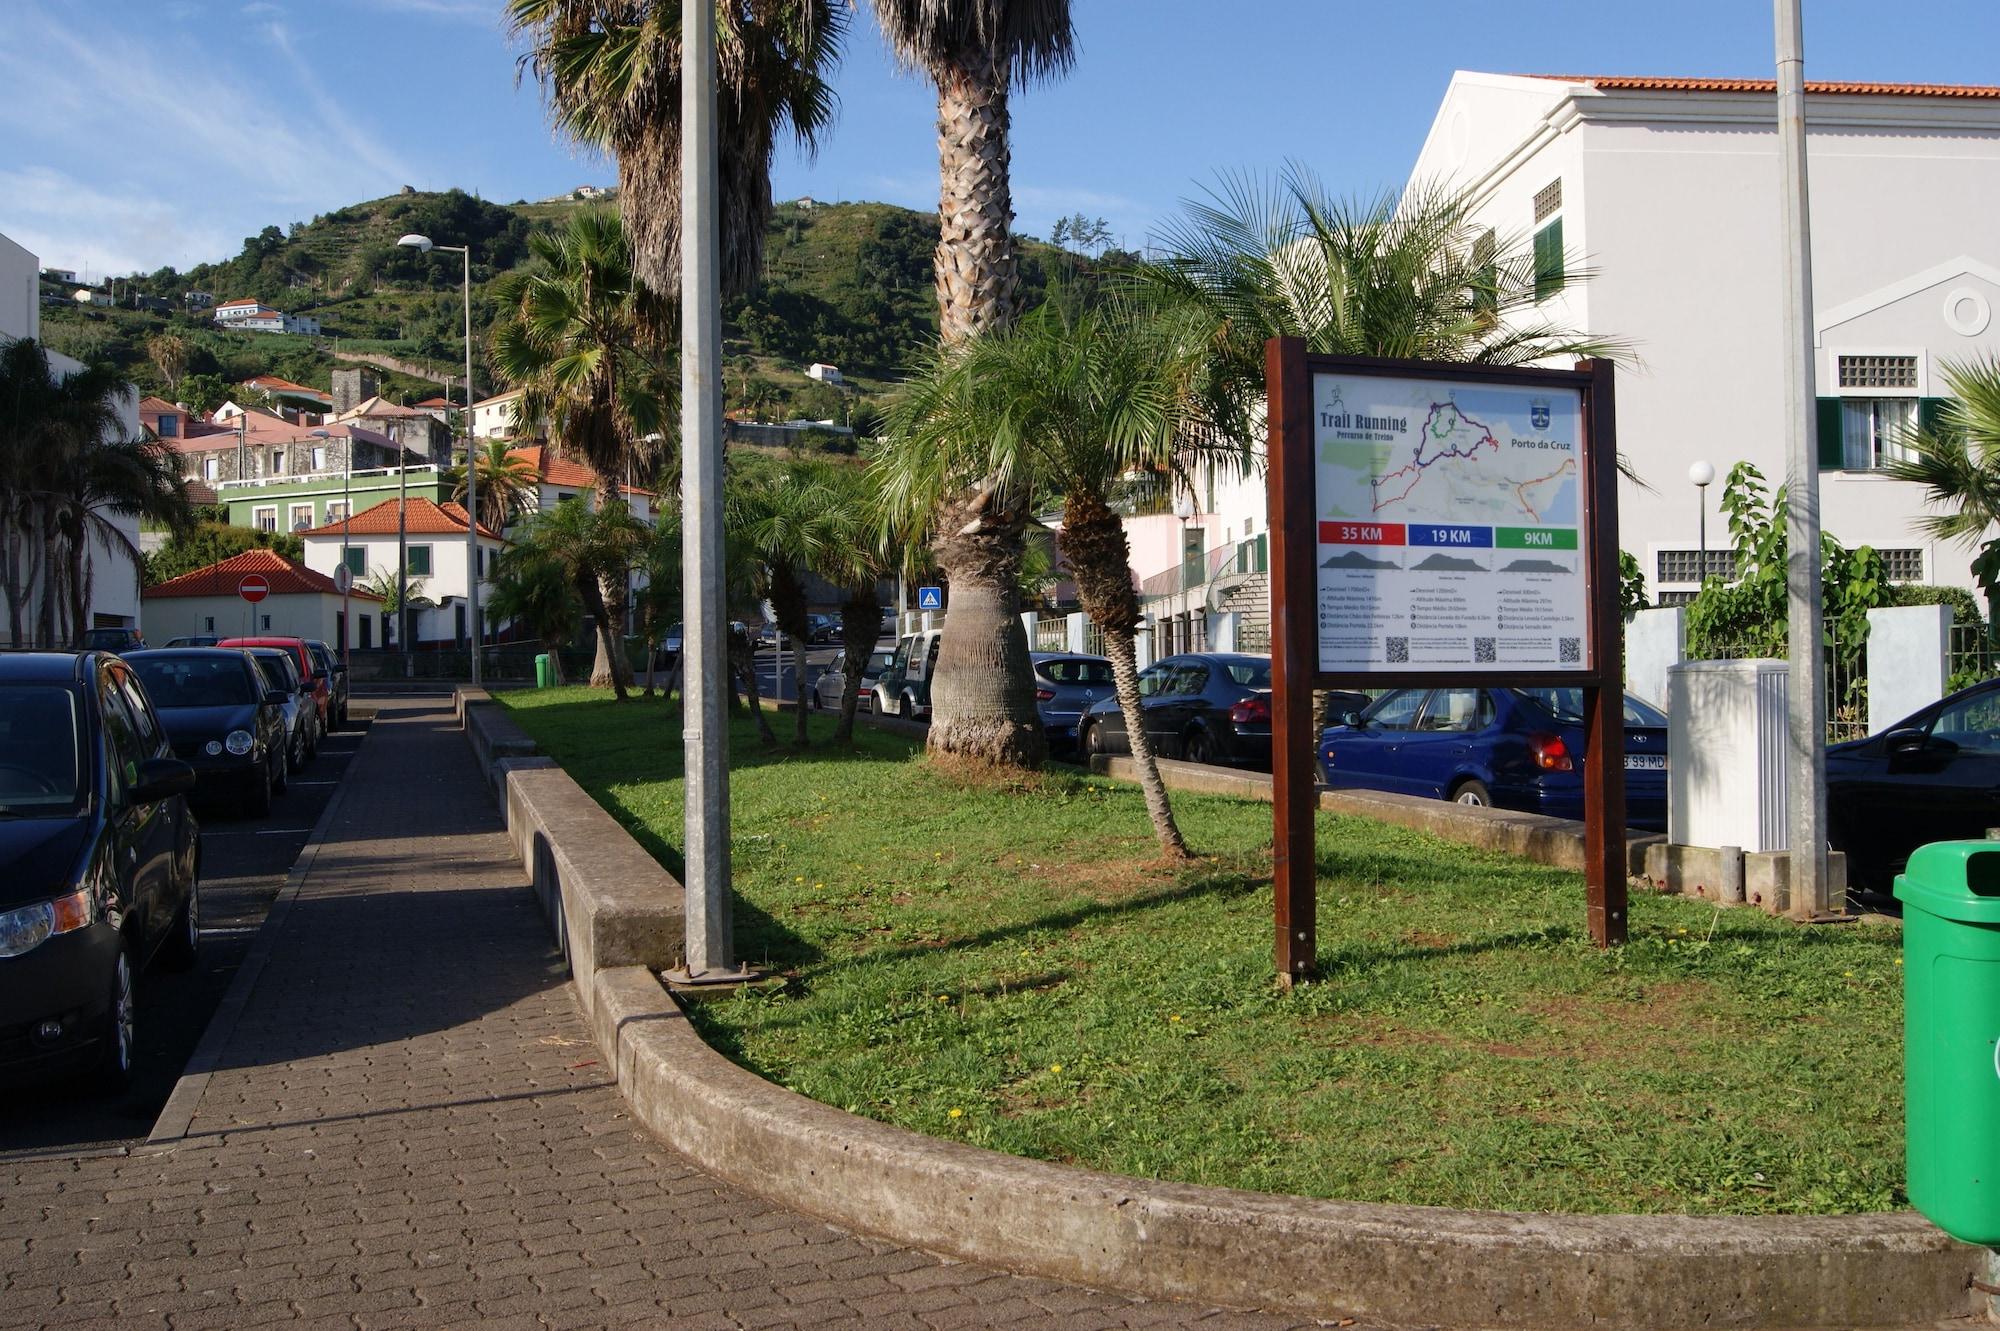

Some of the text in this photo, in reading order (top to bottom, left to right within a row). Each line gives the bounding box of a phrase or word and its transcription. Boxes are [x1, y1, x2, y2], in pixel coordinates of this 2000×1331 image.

[1320, 412, 1407, 433] Trail Running
[1337, 431, 1394, 441] Percurso de Treino
[1511, 438, 1571, 450] Porto da Cruz
[1342, 527, 1382, 541] 35 KM
[1432, 529, 1471, 543] 19 KM
[1524, 532, 1552, 545] 9KM
